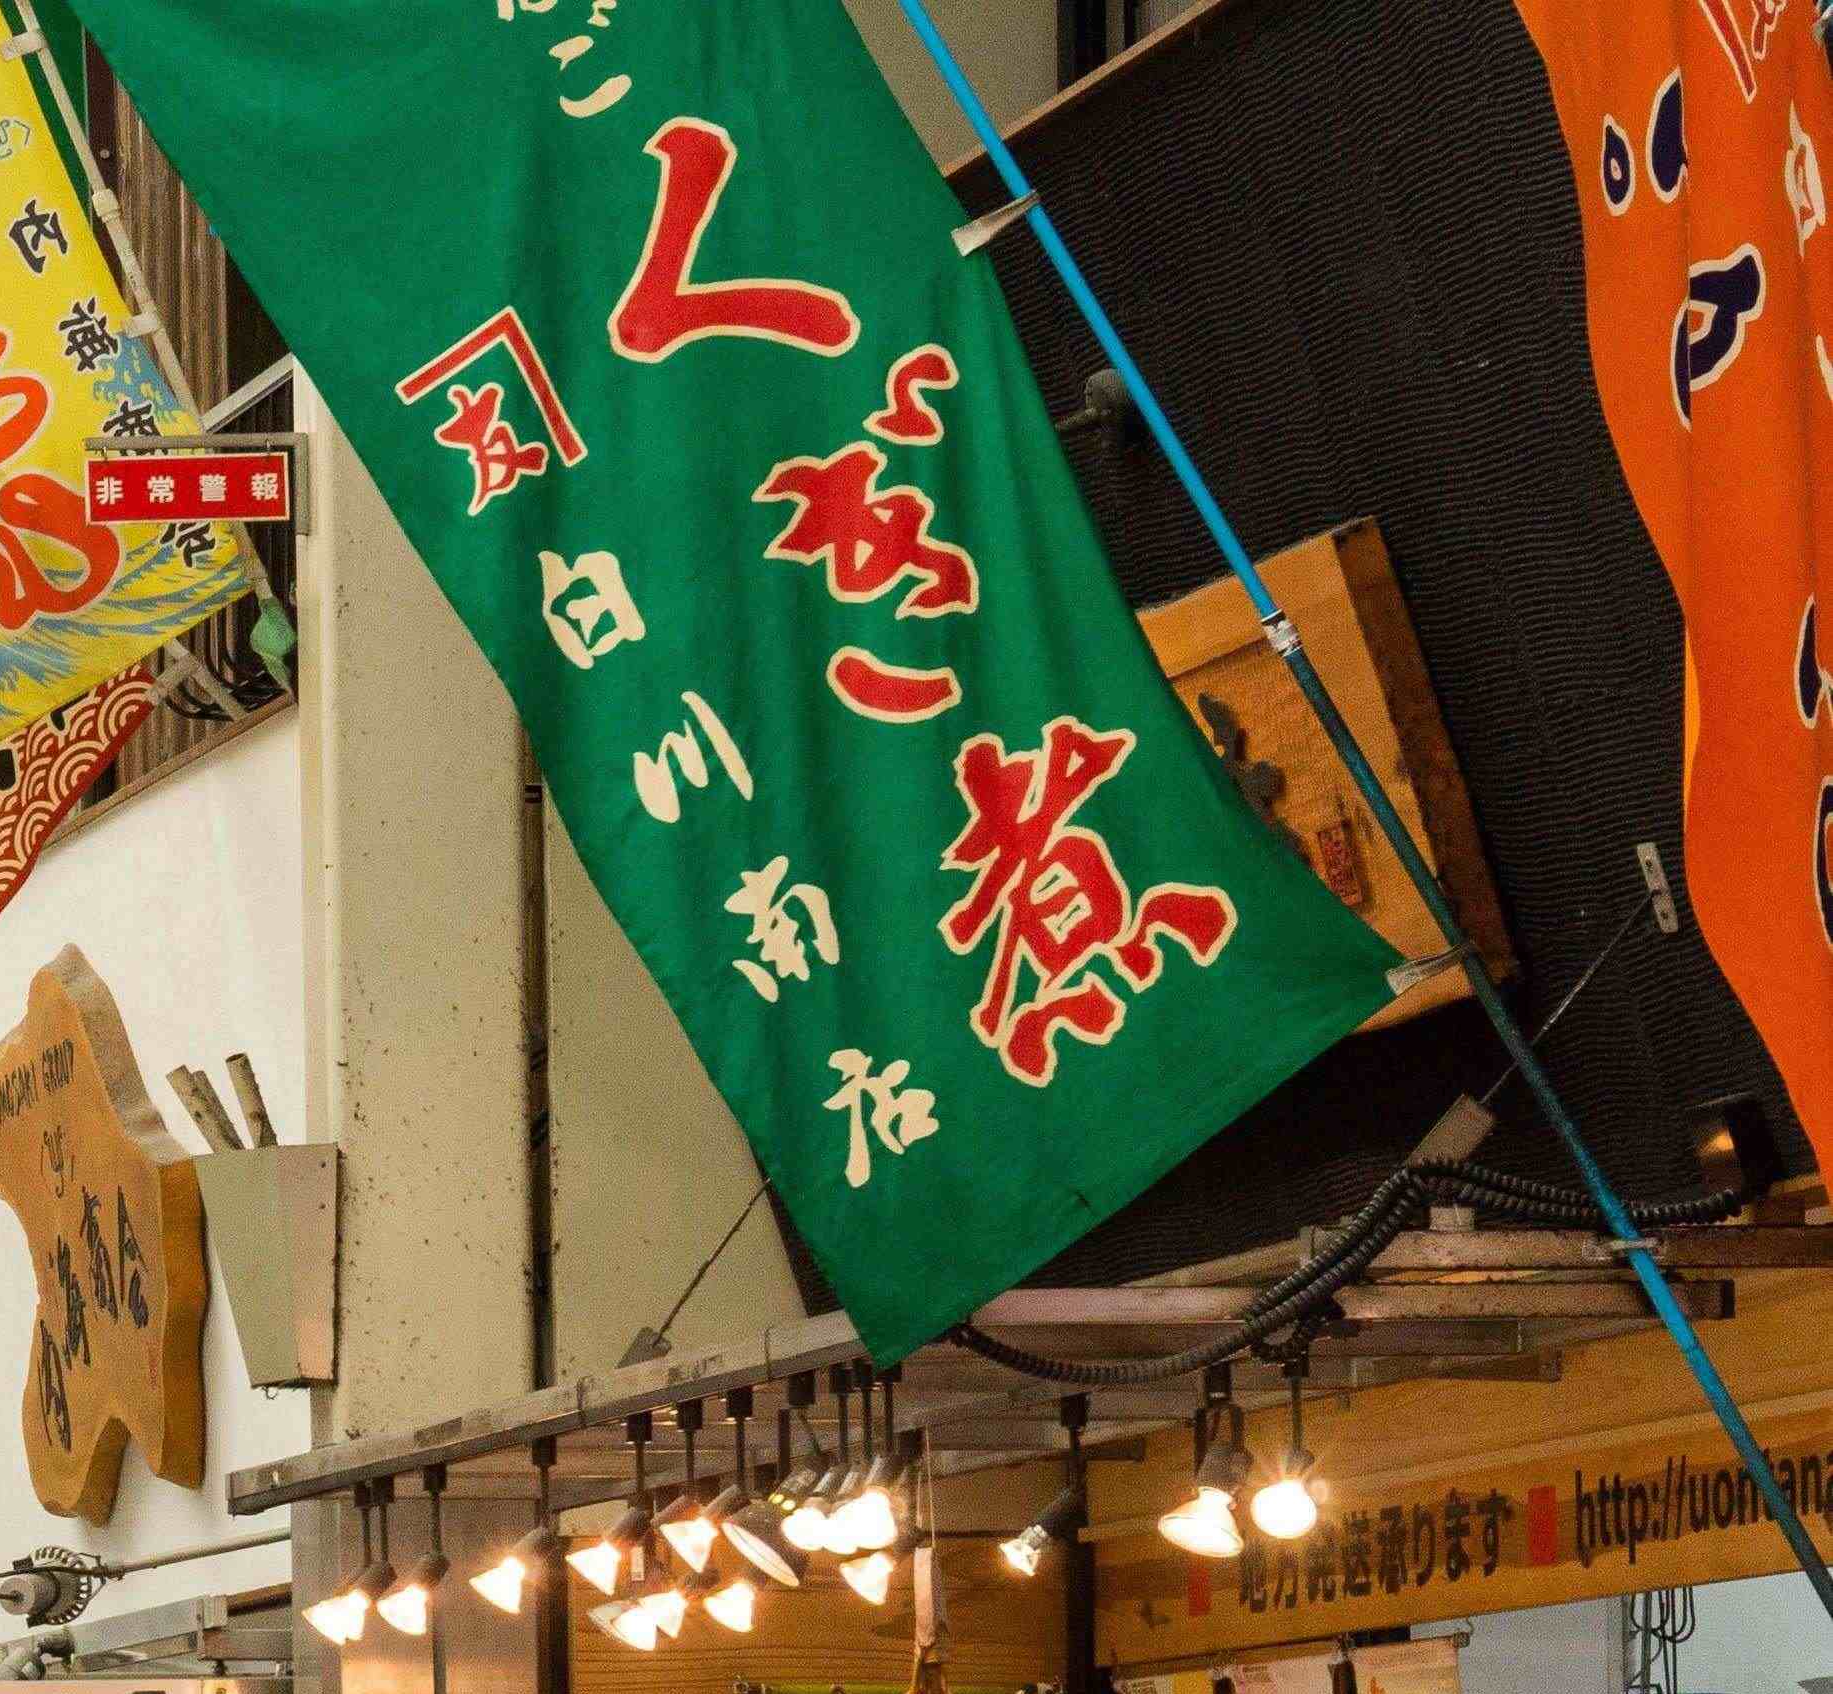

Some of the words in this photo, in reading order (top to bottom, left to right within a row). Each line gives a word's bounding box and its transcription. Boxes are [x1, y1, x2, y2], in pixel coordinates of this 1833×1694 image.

[95, 468, 280, 507] 非常警報
[607, 114, 1238, 1089] くぎ煮
[539, 546, 939, 1187] 白川南店
